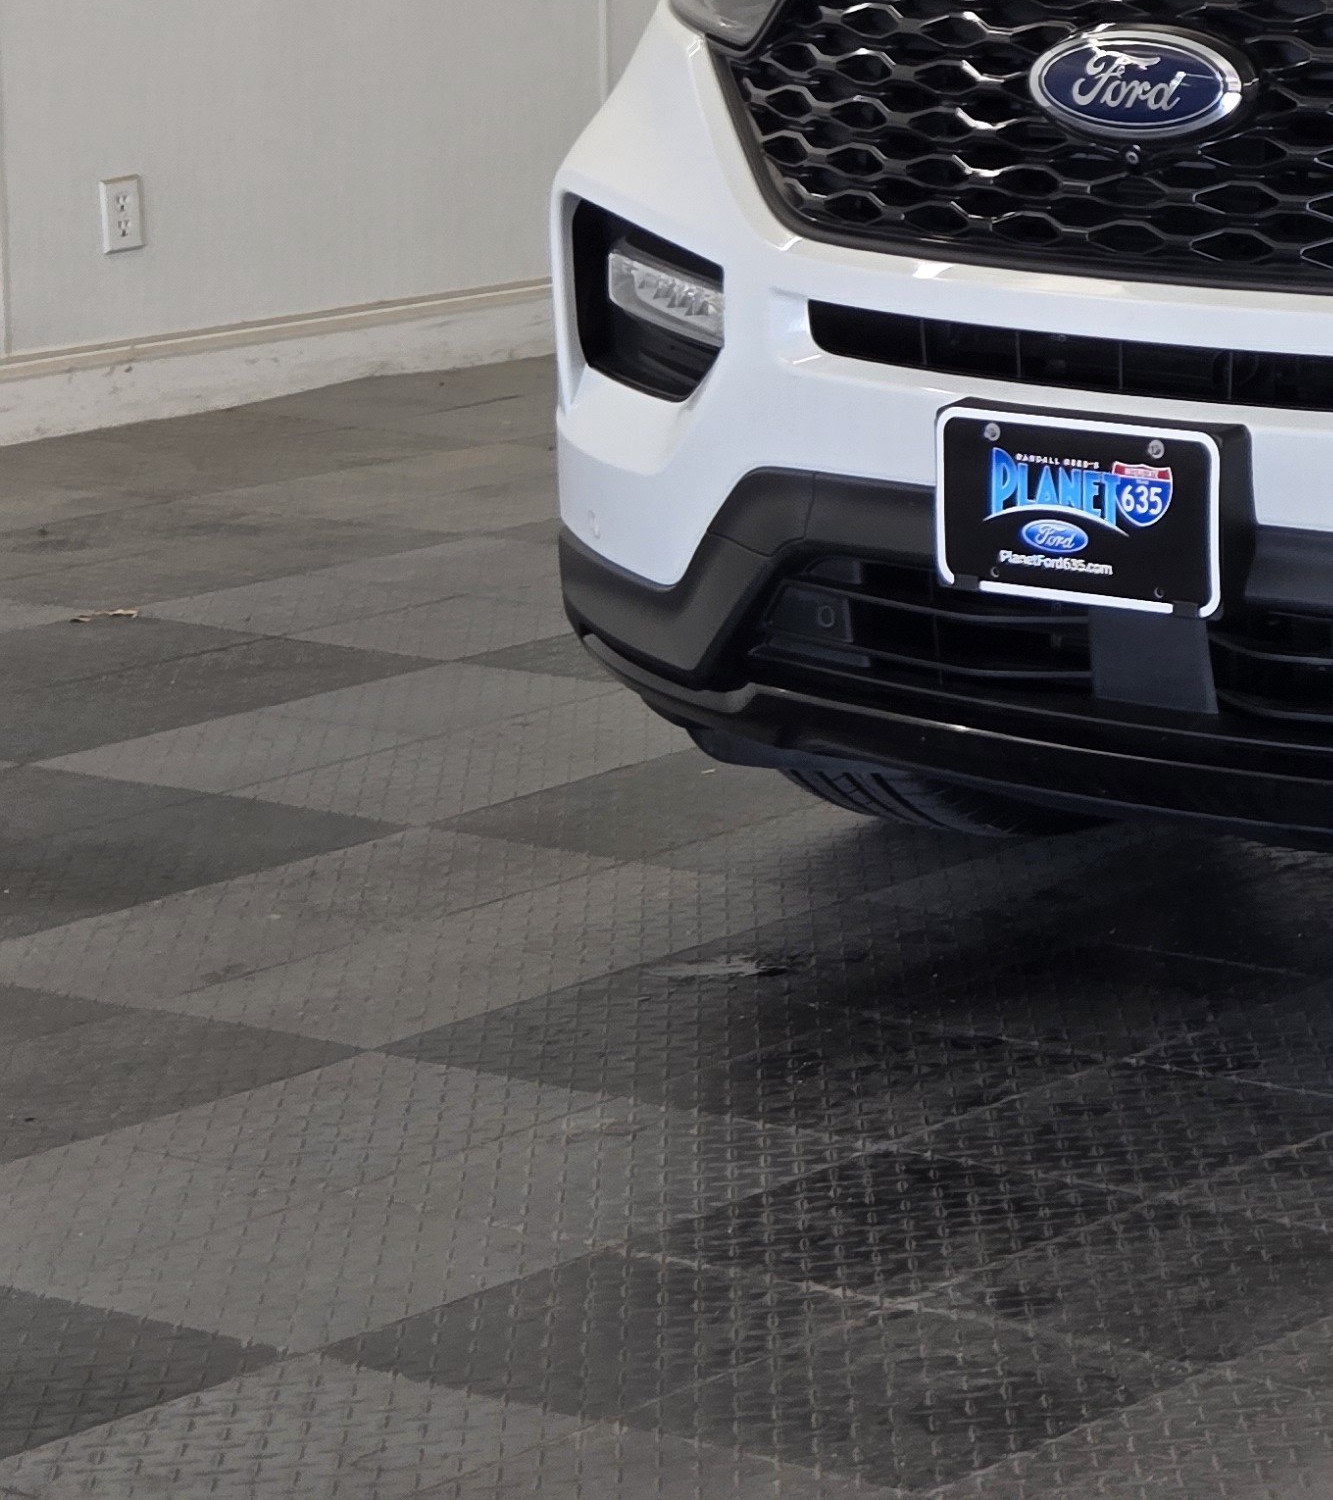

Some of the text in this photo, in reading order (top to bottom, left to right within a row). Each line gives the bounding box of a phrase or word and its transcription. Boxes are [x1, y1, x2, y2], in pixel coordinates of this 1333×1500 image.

[1071, 46, 1187, 112] Ford
[991, 446, 1122, 527] PLANET
[1121, 484, 1163, 515] 635
[1035, 525, 1075, 550] Ford
